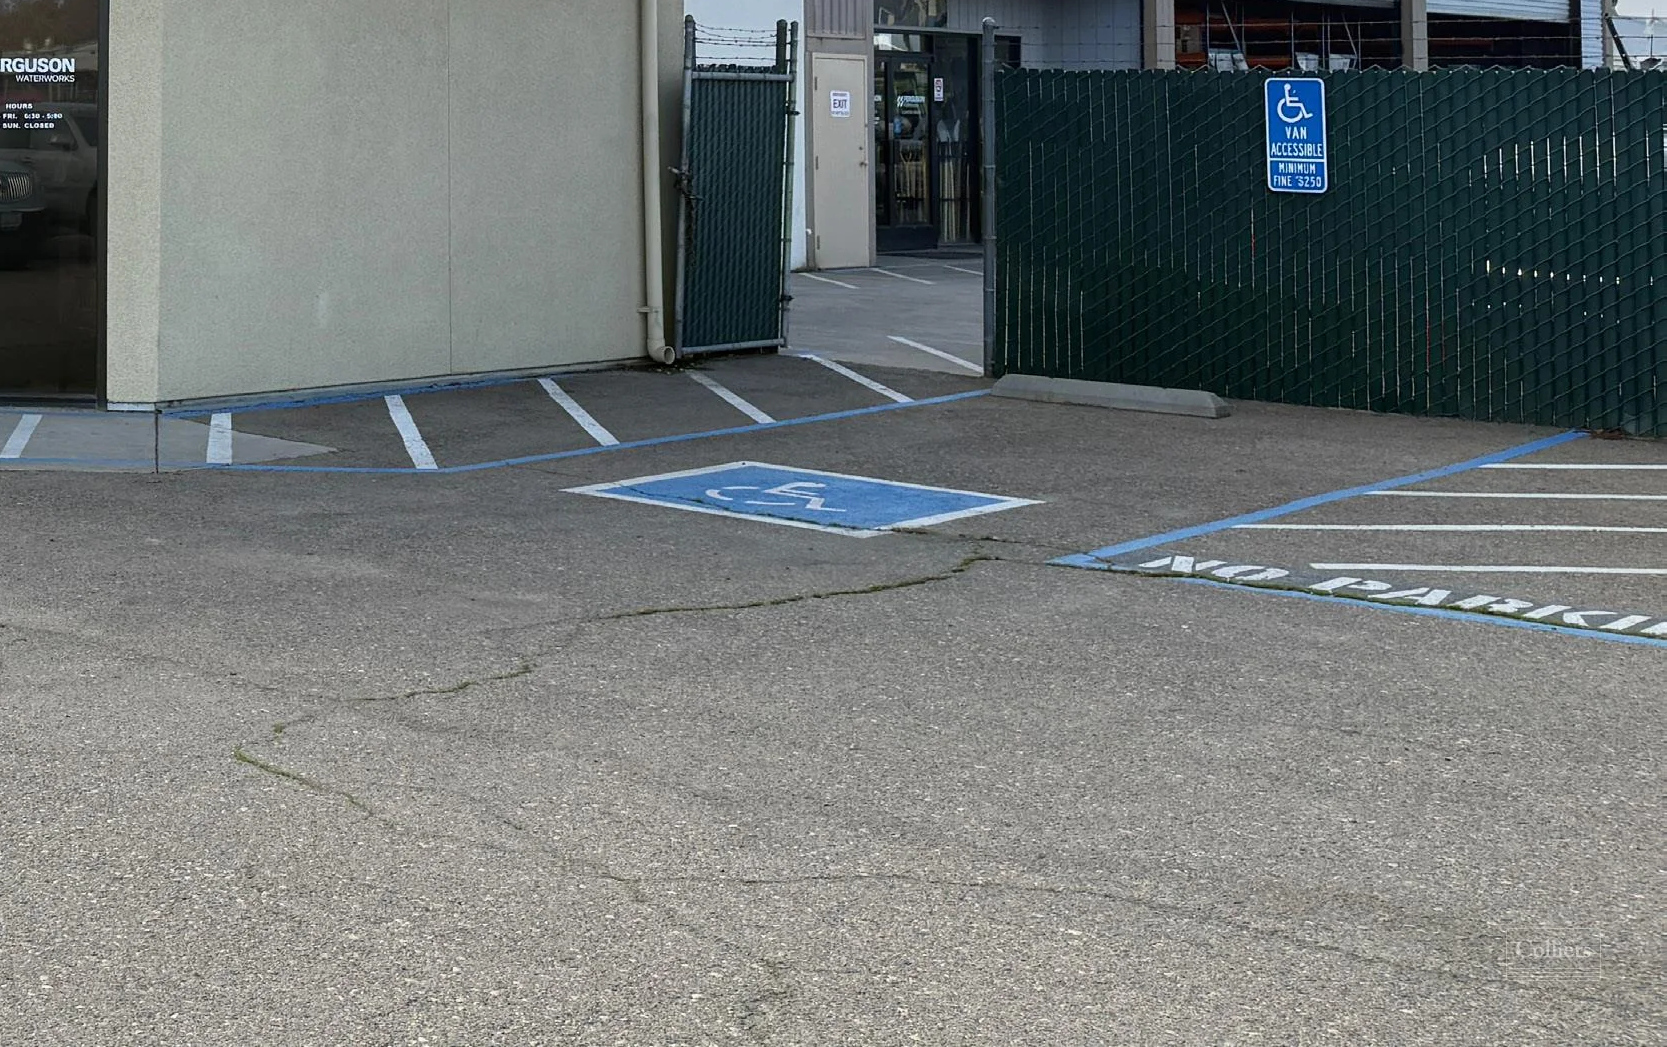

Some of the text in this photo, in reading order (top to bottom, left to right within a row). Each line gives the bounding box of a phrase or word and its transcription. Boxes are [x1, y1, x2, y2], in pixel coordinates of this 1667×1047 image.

[15, 75, 75, 83] WATERWORKS
[833, 99, 847, 109] EXIT
[1285, 126, 1307, 140] VAN
[1271, 142, 1323, 157] ACCESSIBLE
[1278, 162, 1316, 174] MINIMUM
[1273, 175, 1292, 187] FINE
[1138, 555, 1289, 581] NO
